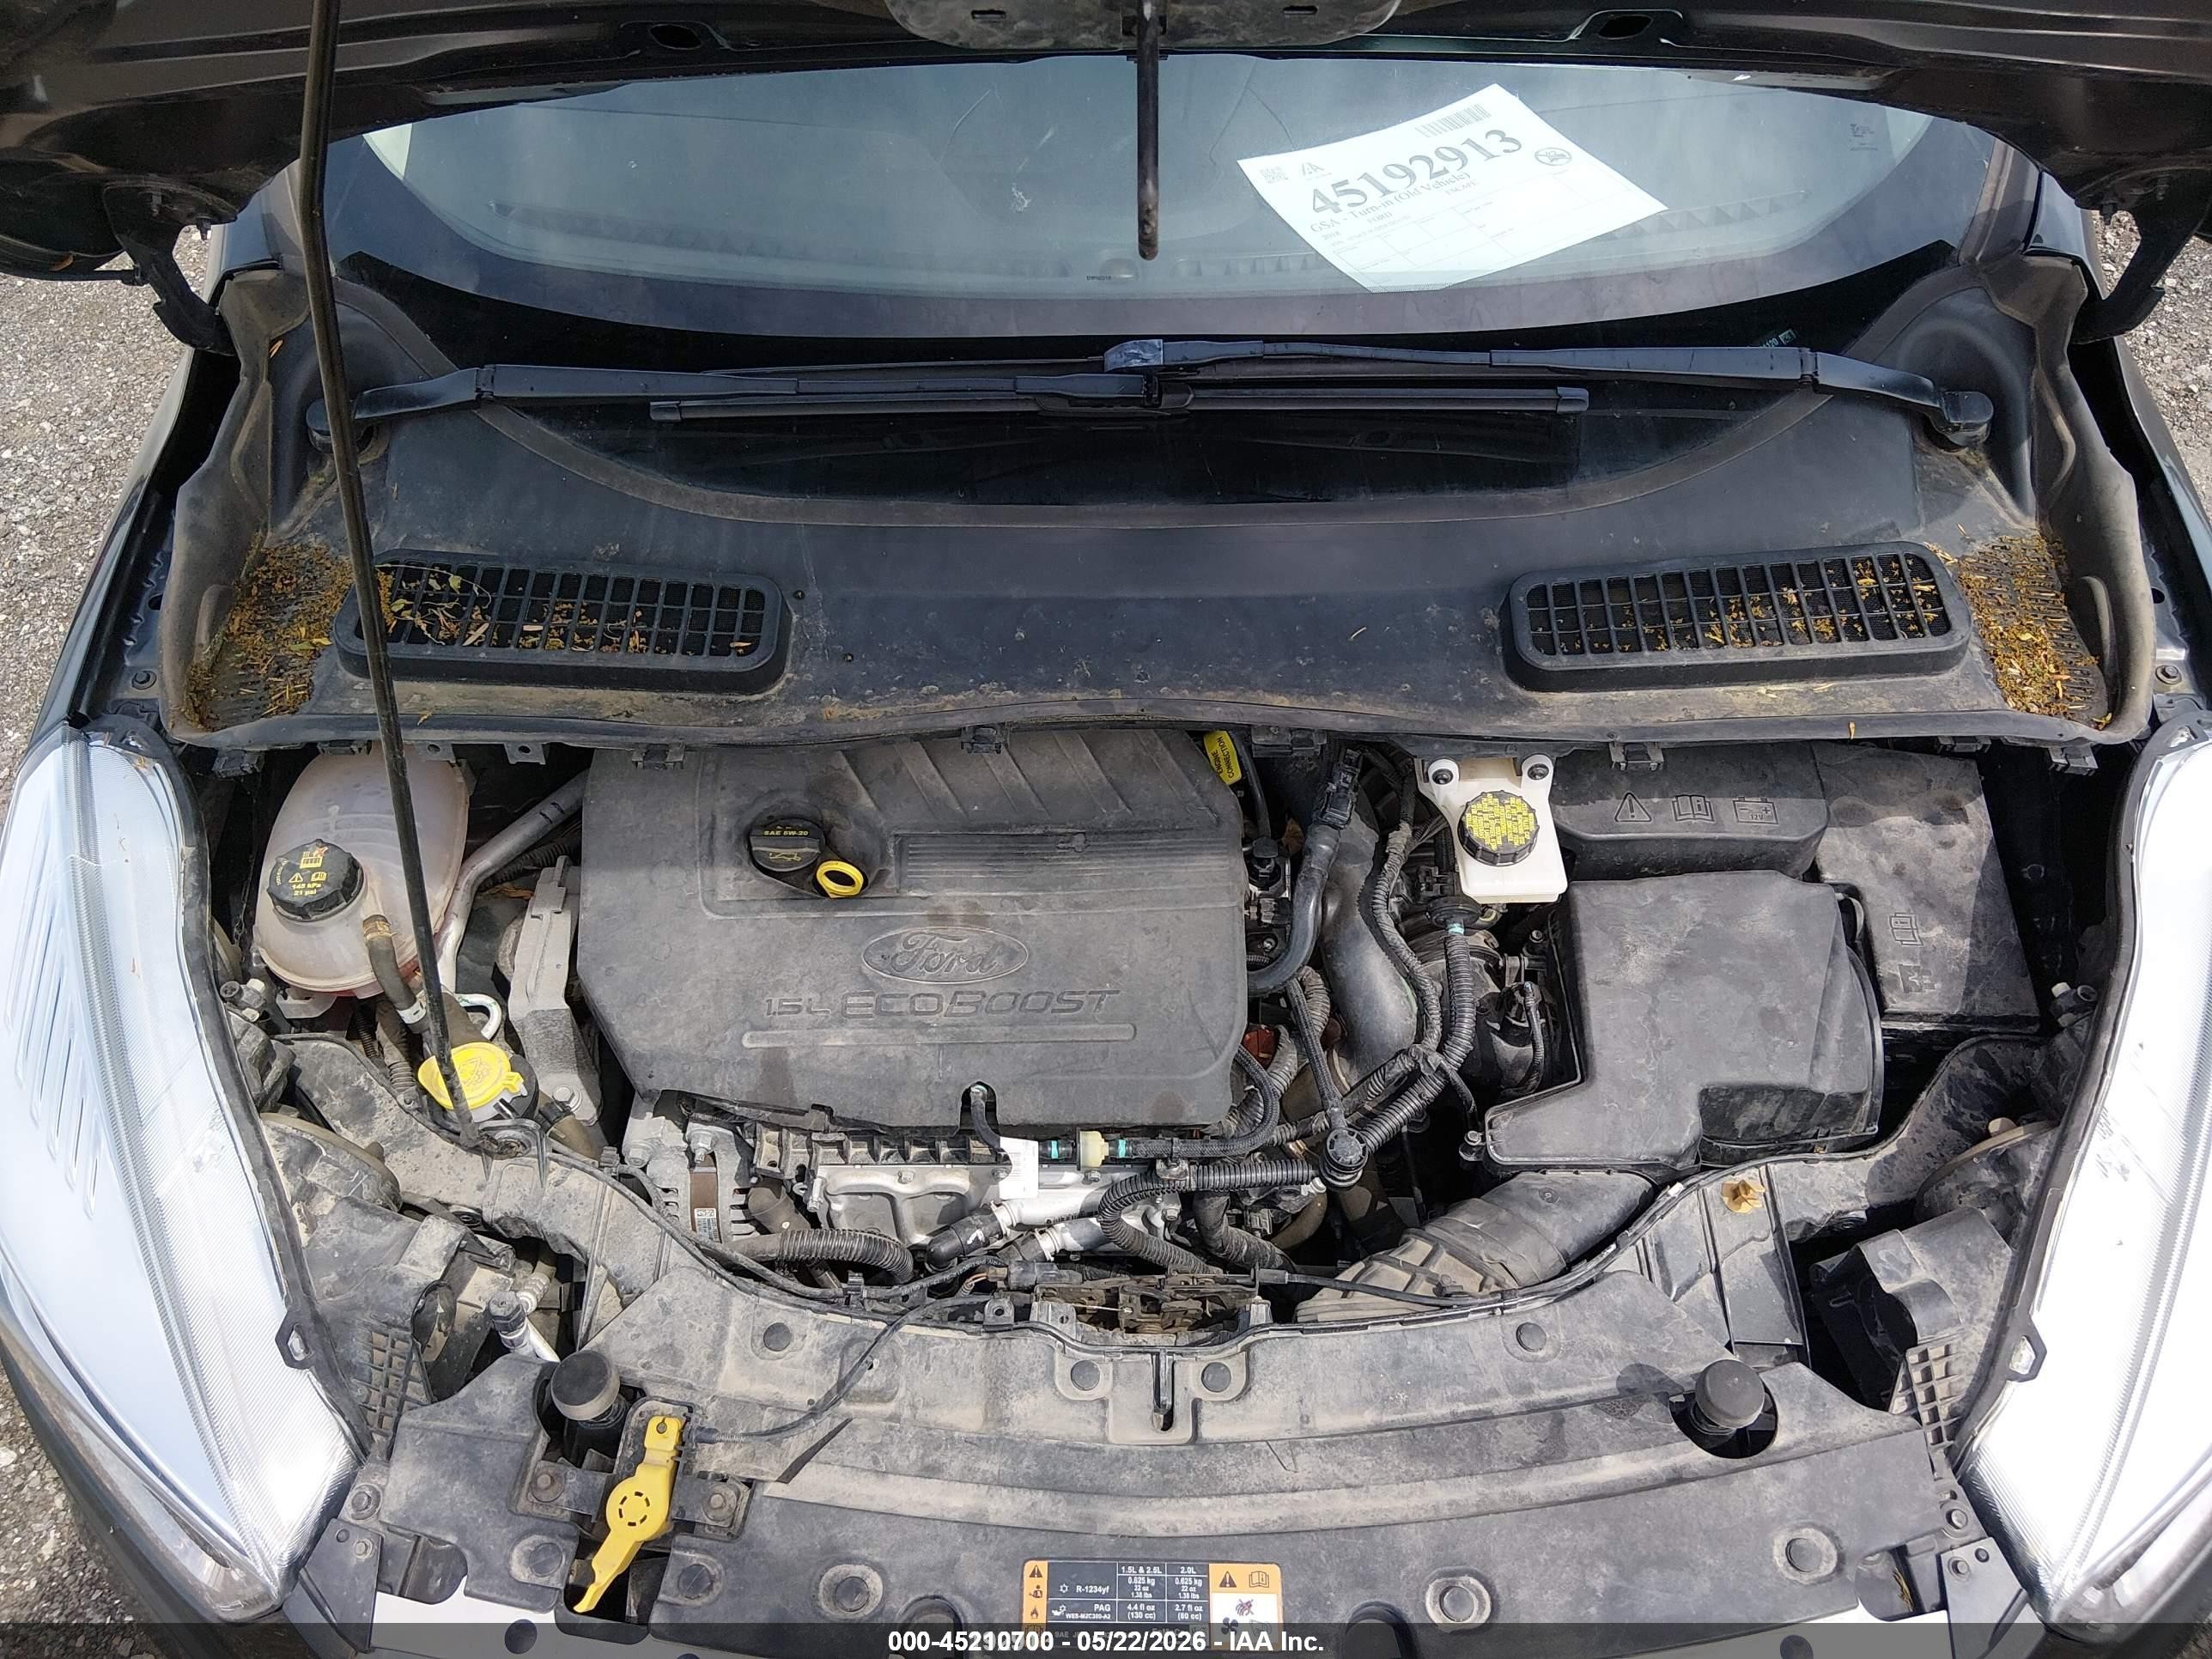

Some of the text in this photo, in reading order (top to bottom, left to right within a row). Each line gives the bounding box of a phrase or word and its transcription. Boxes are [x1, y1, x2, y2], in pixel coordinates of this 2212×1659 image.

[1312, 130, 1522, 213] 45192913
[1310, 218, 1340, 233] GSA
[1349, 198, 1395, 219] Turn-in
[1395, 187, 1419, 204] (Old
[1419, 172, 1471, 191] Vehicle)
[1211, 750, 1224, 774] ENGINE
[1216, 736, 1235, 779] CONNECTION
[890, 931, 1000, 974] Ford
[766, 989, 1121, 1018] 1.5L ECOBOOST
[1076, 1585, 1110, 1595] R-1234yf
[1146, 1577, 1156, 1587] kg
[1194, 1577, 1202, 1588] kg
[1127, 1612, 1143, 1620] (130
[1190, 1613, 1202, 1621] cc)
